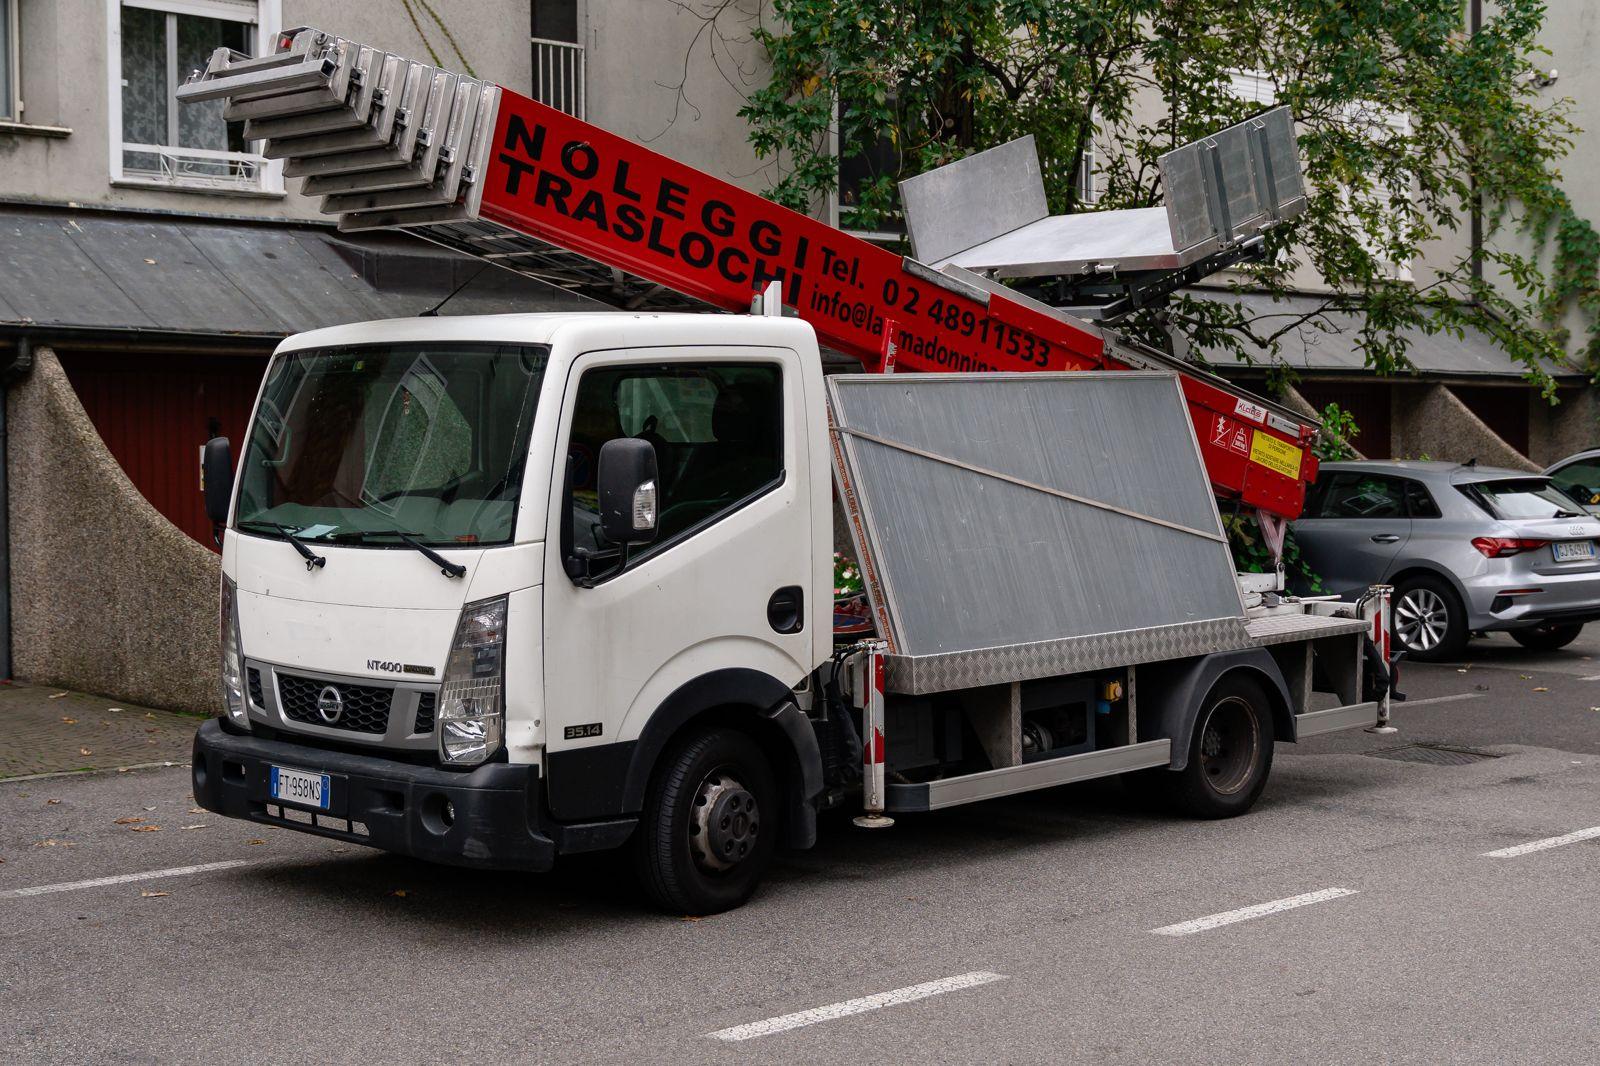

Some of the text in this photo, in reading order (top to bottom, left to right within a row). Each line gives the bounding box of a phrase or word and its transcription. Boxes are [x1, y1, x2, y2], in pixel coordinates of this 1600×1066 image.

[499, 152, 803, 306] TRASLOCHI
[503, 114, 809, 270] NOLEGGI
[820, 246, 865, 290] Tel.
[927, 298, 1049, 368] 48911533
[367, 659, 402, 673] NT400
[566, 724, 601, 738] 35.14
